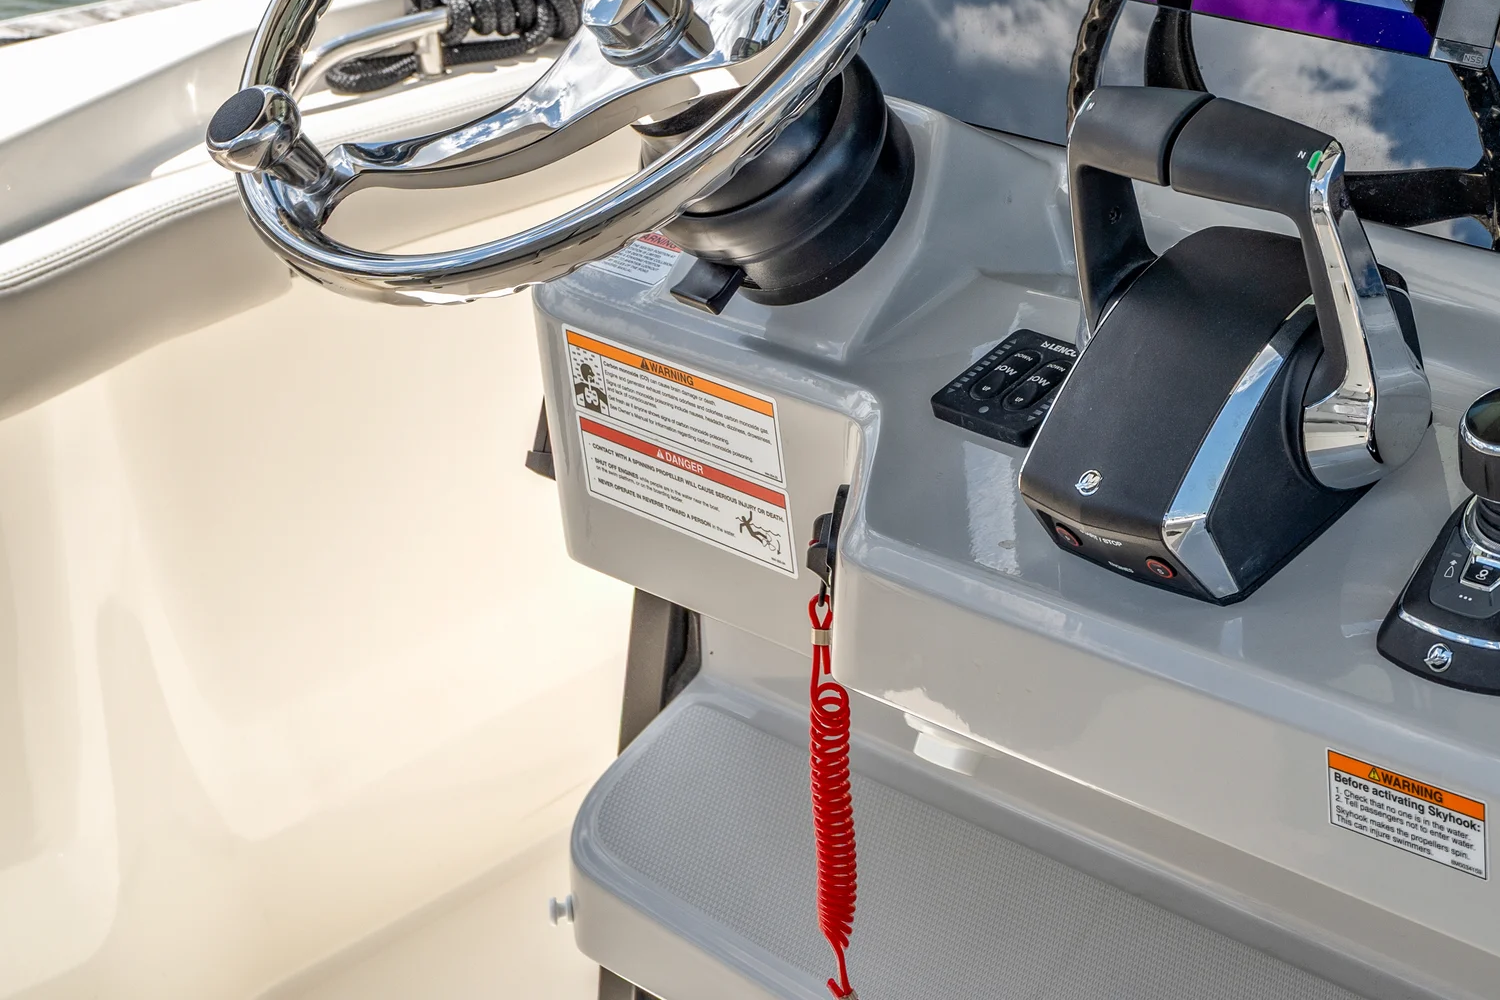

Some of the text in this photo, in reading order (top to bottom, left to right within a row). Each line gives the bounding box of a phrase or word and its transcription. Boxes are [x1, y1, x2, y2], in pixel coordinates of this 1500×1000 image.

[1297, 150, 1306, 159] N
[649, 362, 694, 386] WARNING
[665, 451, 704, 475] DANGER
[1334, 771, 1481, 834] Before activating Skyhook:
[1381, 772, 1443, 803] WARNING
[1335, 786, 1471, 841] 1. Check that no one is in the water.
[1335, 794, 1476, 851] 2. Tell passengers not to enter water.
[1336, 804, 1470, 861] Skyhook makes the propellers spin.
[1336, 814, 1434, 856] This can injure swimmers.
